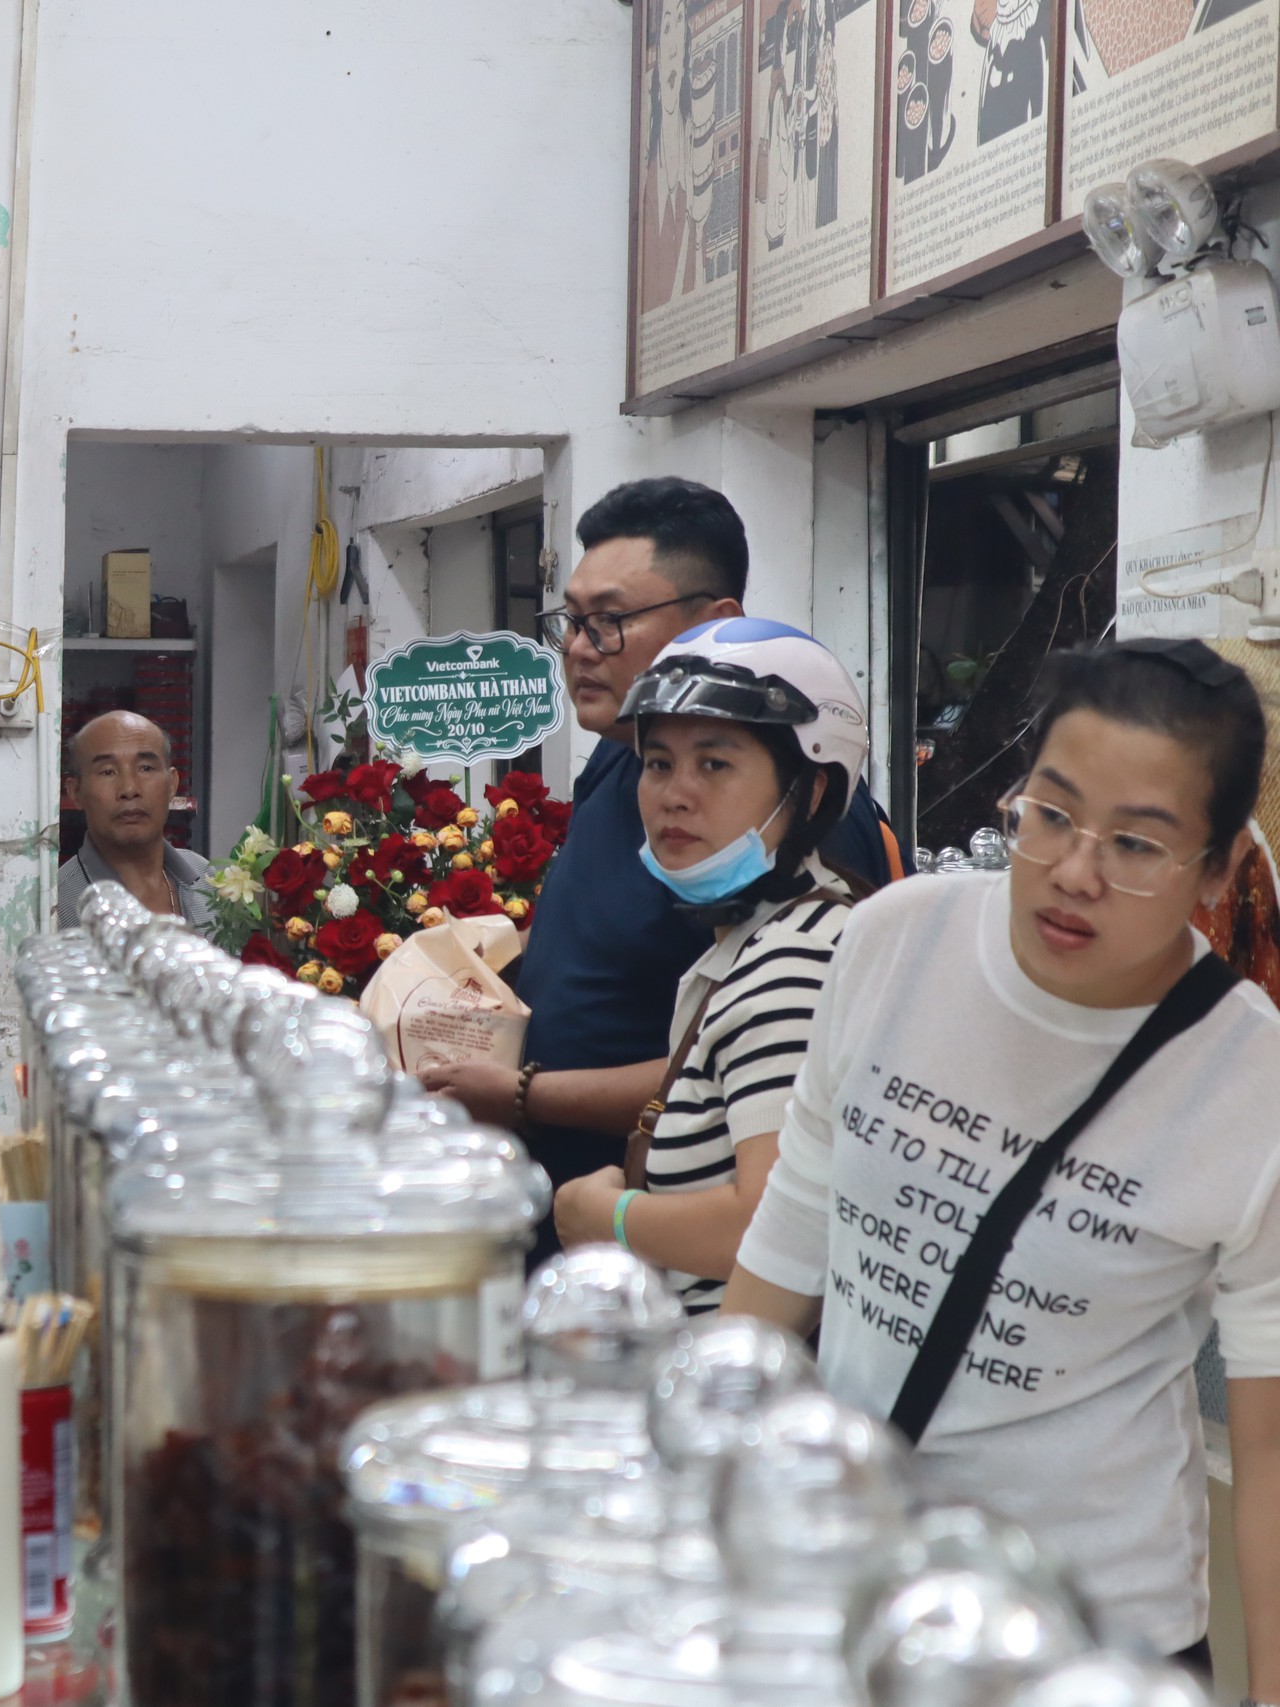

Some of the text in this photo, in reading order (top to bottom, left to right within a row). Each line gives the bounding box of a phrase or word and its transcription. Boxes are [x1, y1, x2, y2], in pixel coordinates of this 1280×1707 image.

[426, 657, 501, 673] Vietcombank
[380, 675, 548, 704] VIETCOMBANK HÀ THÀNH
[379, 697, 551, 729] Chúc mừng Ngày Phụ nữ Việt Nam
[447, 723, 486, 737] 20/10
[883, 1076, 992, 1142] BEFORE
[1055, 1151, 1144, 1209] WERE
[890, 1127, 926, 1162] TO
[936, 1147, 991, 1196] TILL
[1068, 1208, 1140, 1245] OWN
[920, 1241, 963, 1275] OU
[858, 1249, 1027, 1347] WERE NG
[831, 1266, 856, 1309] WE
[861, 1293, 926, 1352] WHER
[965, 1352, 1043, 1392] HERE
